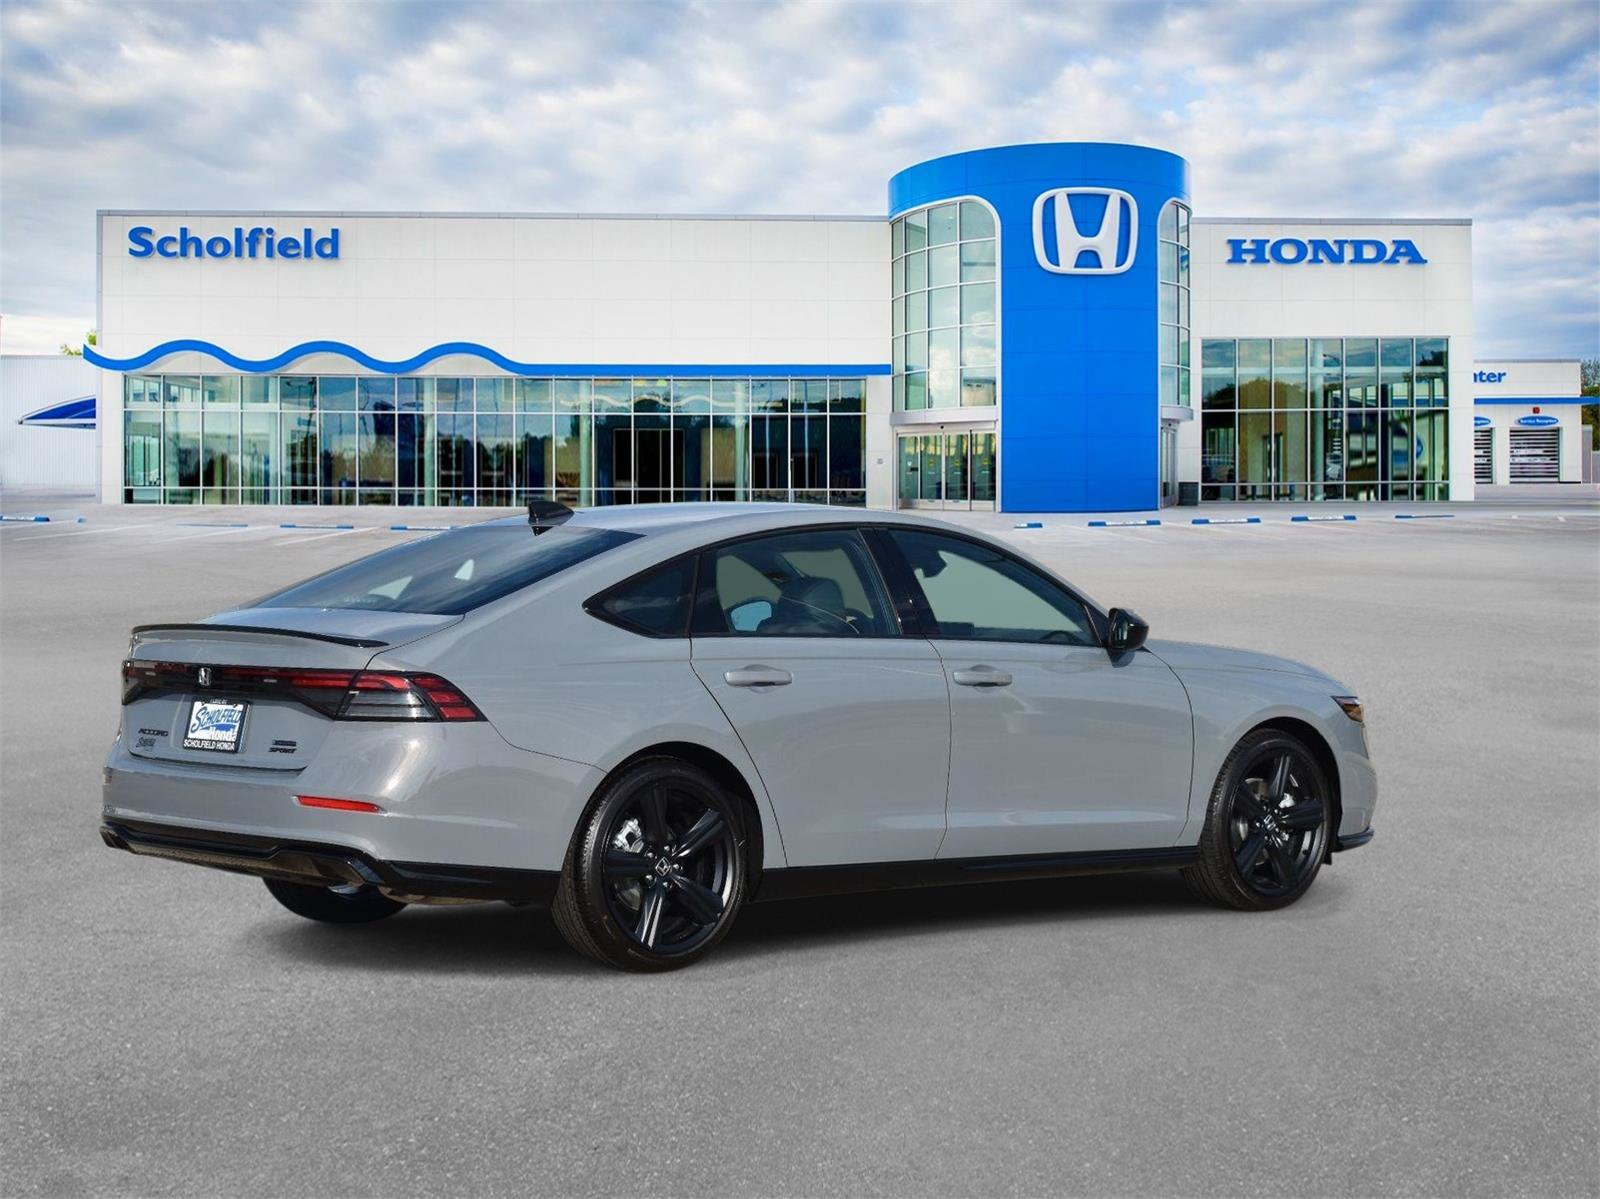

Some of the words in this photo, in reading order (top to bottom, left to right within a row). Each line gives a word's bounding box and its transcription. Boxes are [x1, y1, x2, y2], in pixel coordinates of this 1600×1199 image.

[128, 226, 340, 258] Scholfield
[1227, 238, 1428, 264] HONDA
[138, 728, 169, 737] ACCORD
[184, 738, 216, 750] SCHOLFIELD
[216, 741, 236, 751] HONDA
